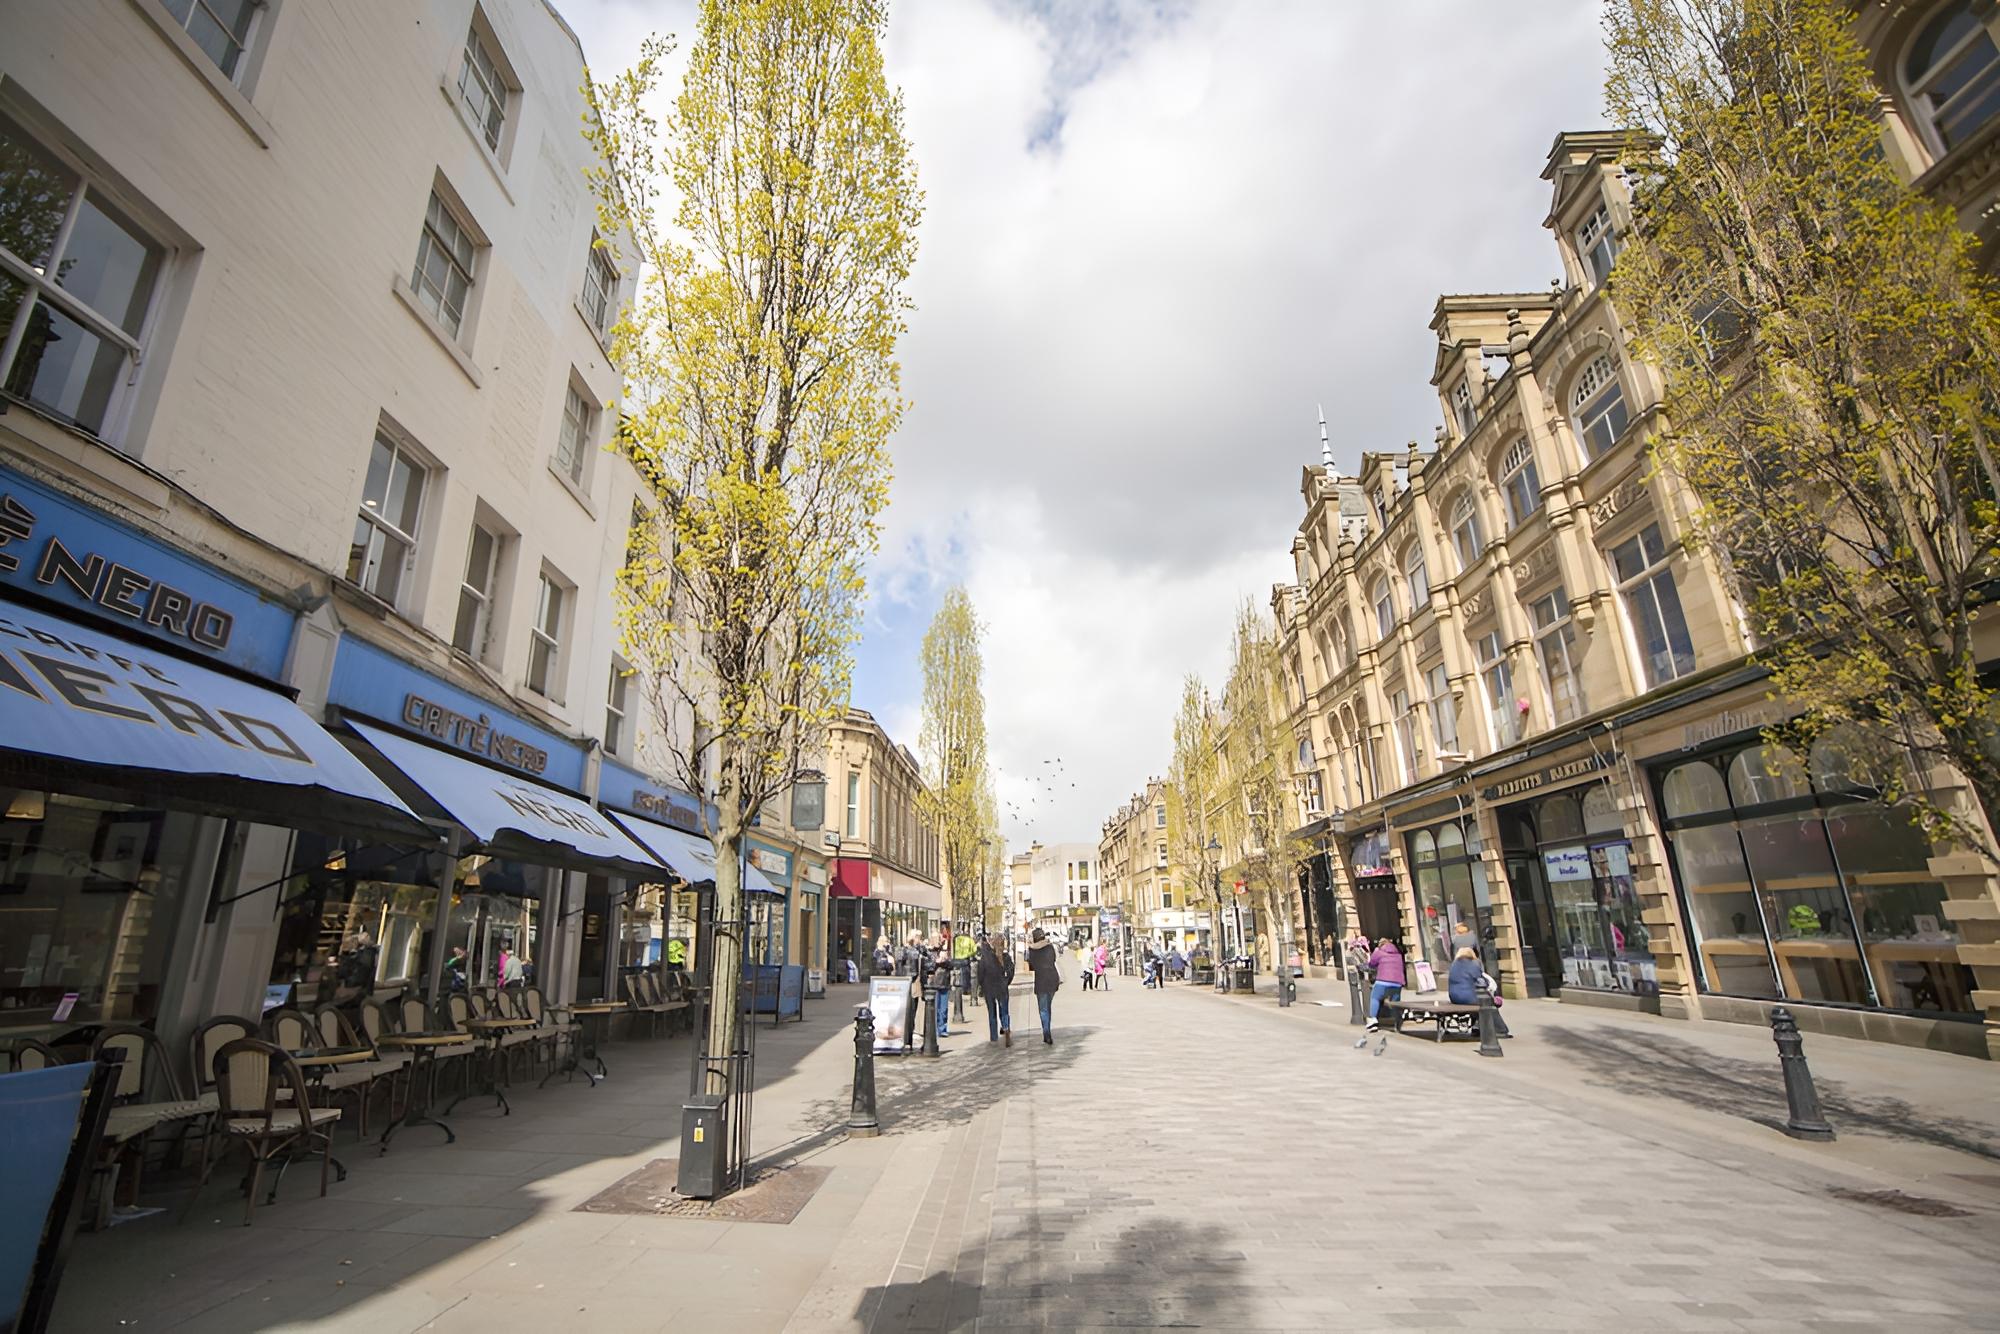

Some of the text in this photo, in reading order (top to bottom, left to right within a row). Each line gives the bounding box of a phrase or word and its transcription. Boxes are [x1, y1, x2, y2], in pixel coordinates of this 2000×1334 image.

[36, 537, 233, 651] NERO
[488, 729, 547, 775] NERO
[493, 788, 610, 839] NERO
